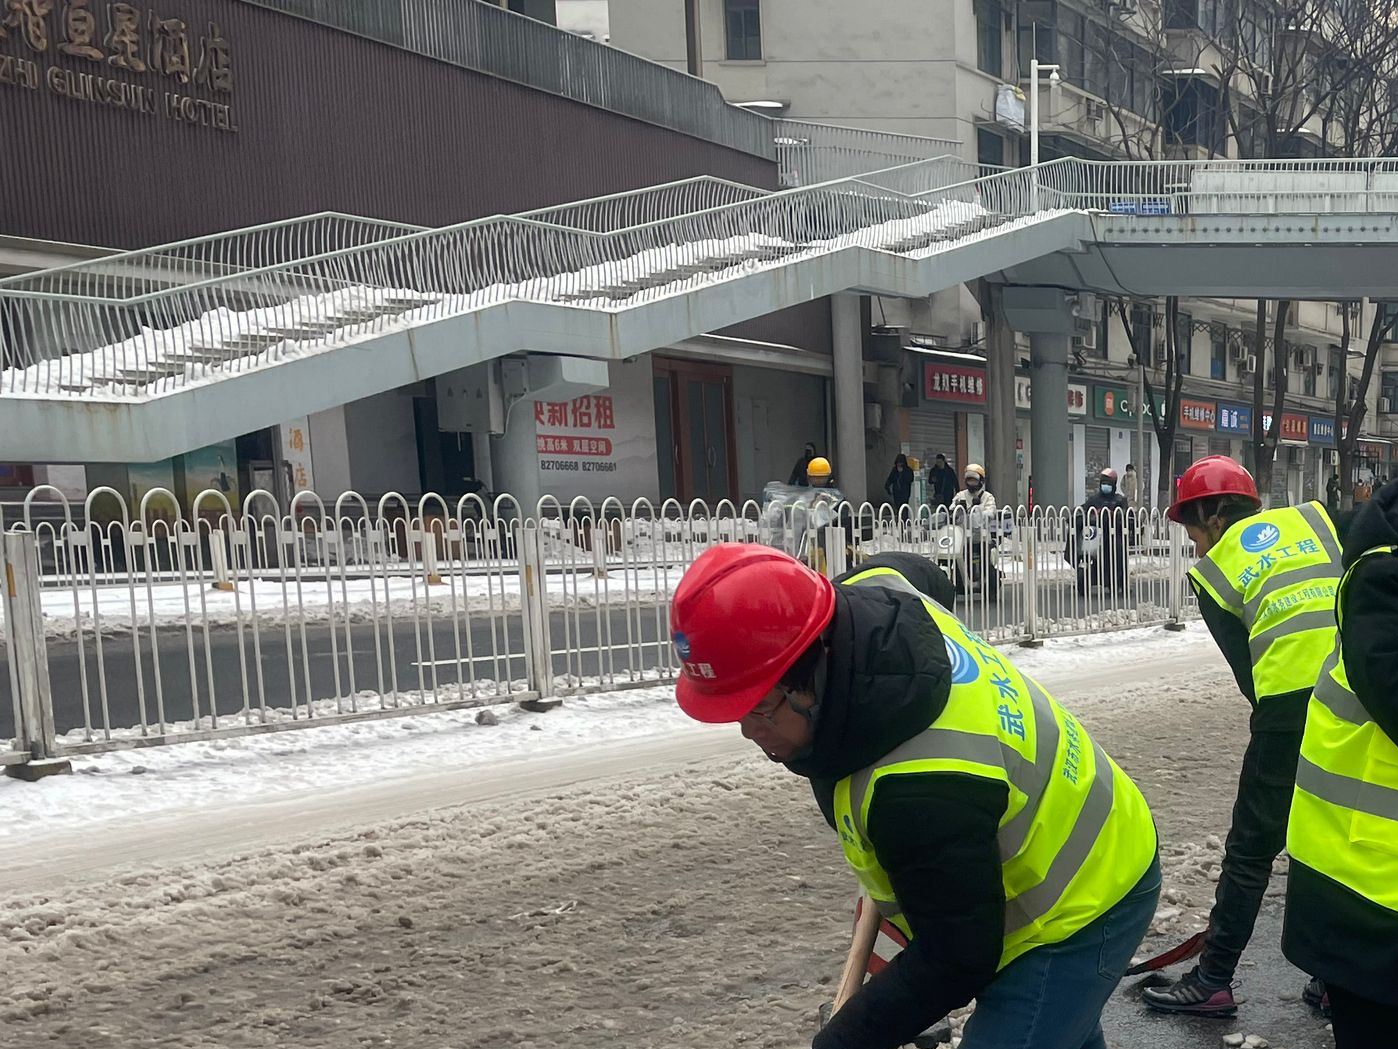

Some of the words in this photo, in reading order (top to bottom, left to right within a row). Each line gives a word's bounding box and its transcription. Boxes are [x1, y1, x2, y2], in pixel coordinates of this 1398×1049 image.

[164, 91, 238, 133] HOTEL
[288, 427, 308, 488] 酒店
[1237, 538, 1320, 590] 武水工程
[683, 662, 717, 679] 工程
